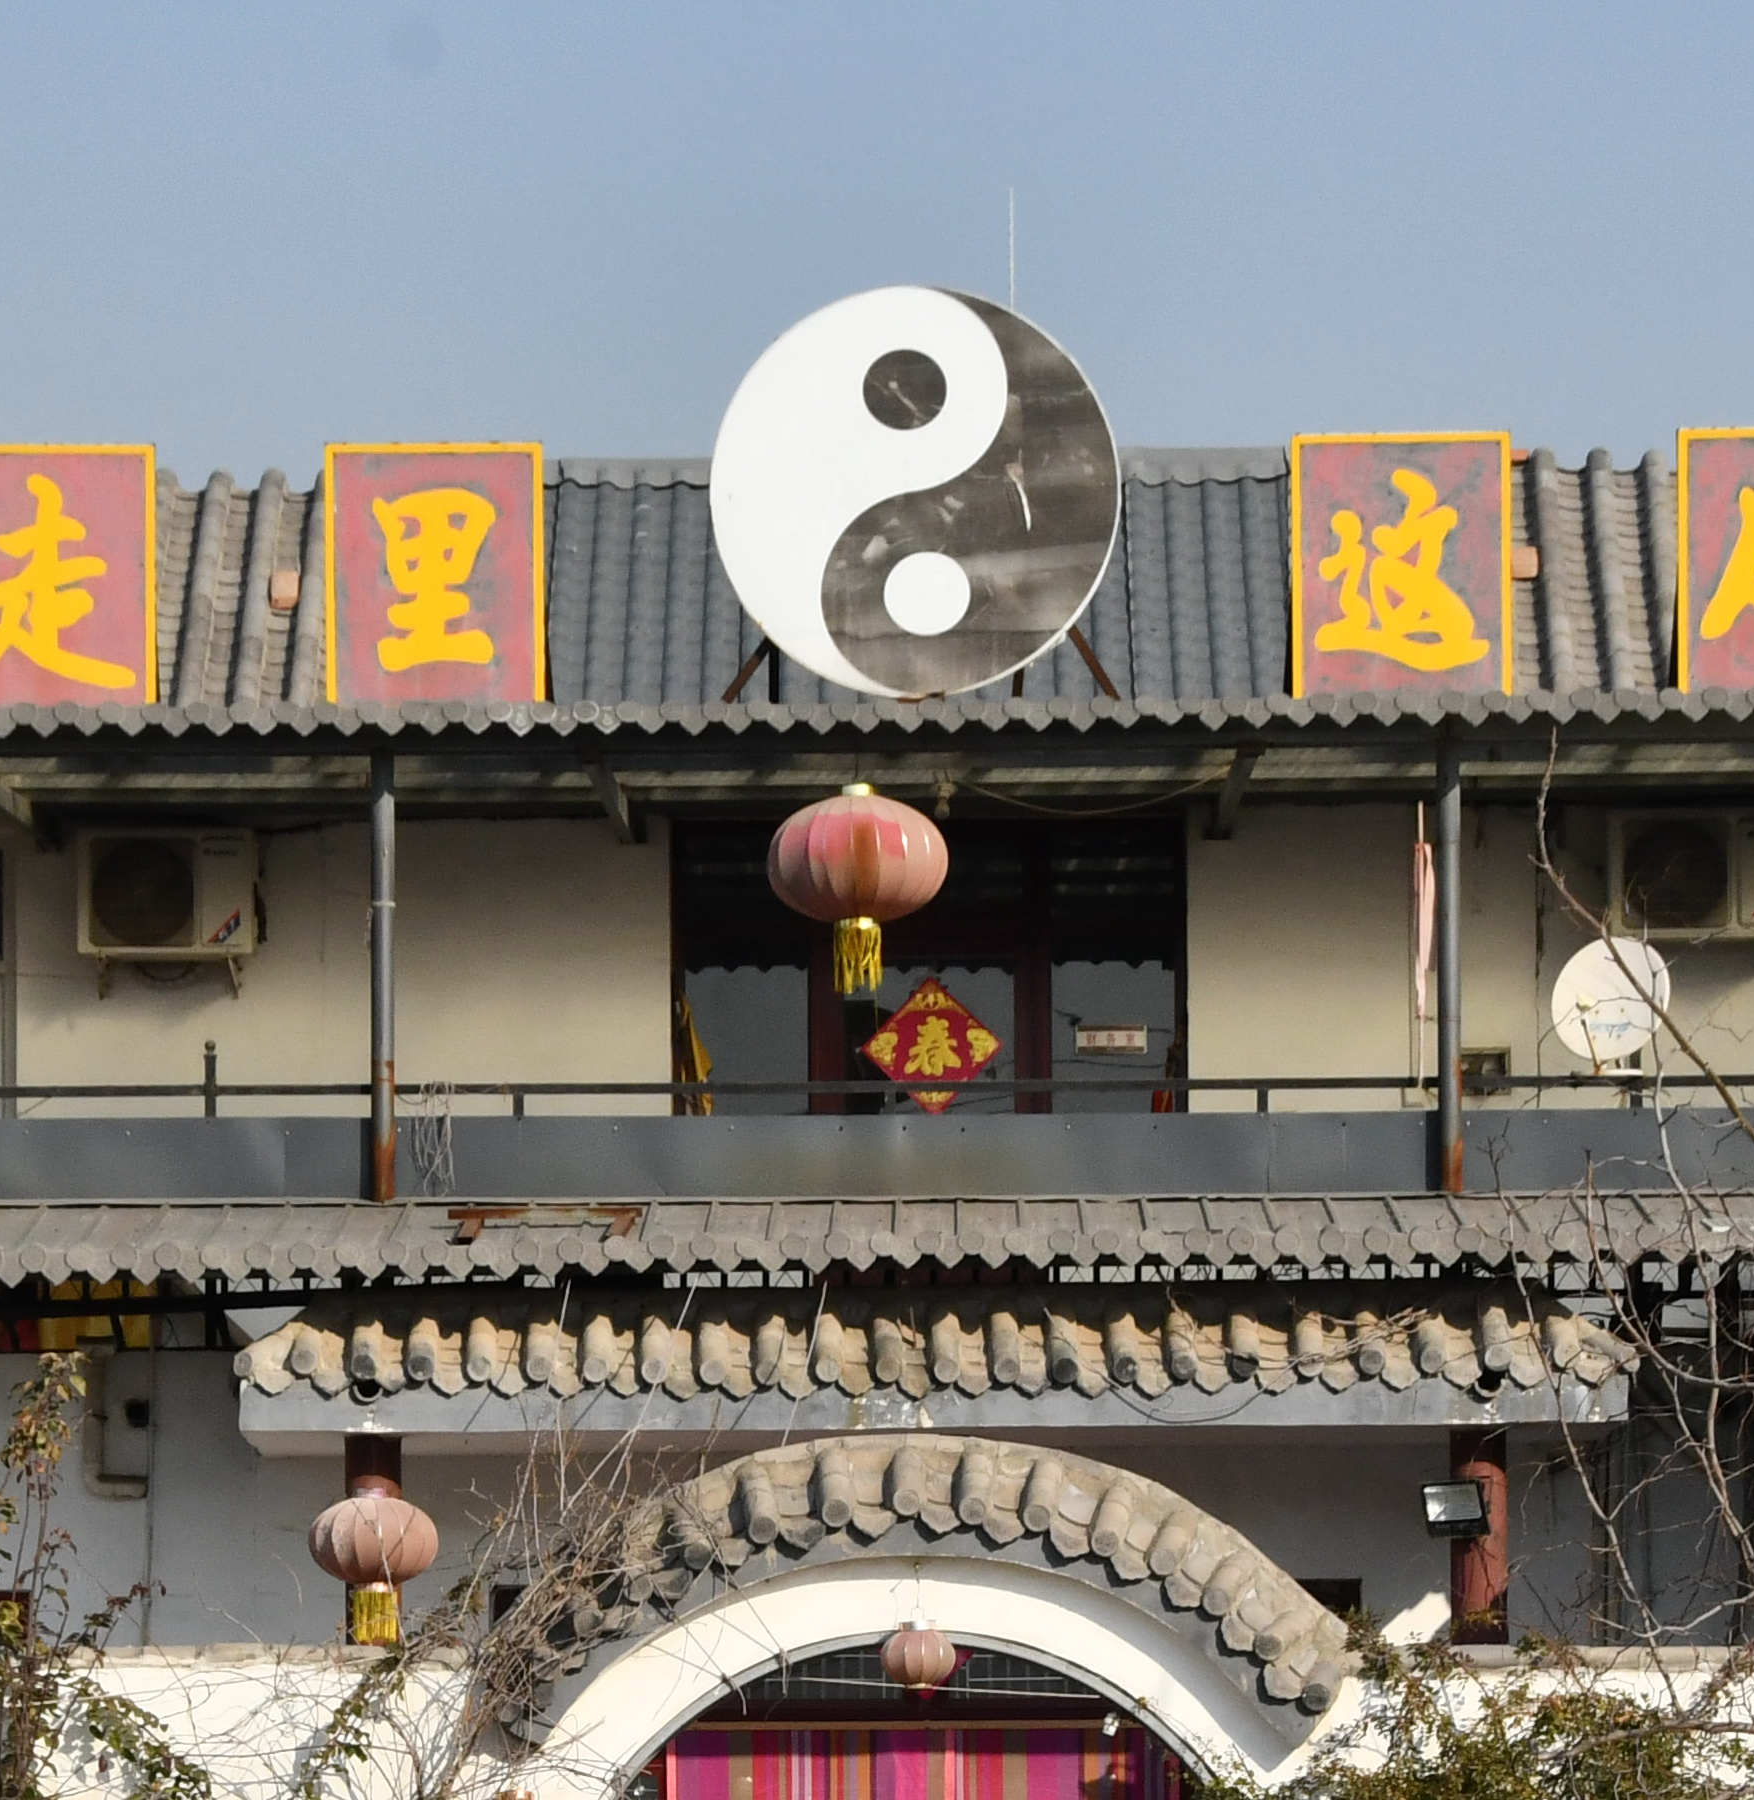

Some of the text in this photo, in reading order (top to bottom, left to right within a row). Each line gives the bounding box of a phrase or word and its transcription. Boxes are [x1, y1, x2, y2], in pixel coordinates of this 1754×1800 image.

[372, 487, 497, 672] 里
[1315, 469, 1490, 671] 这
[904, 1015, 962, 1077] 春
